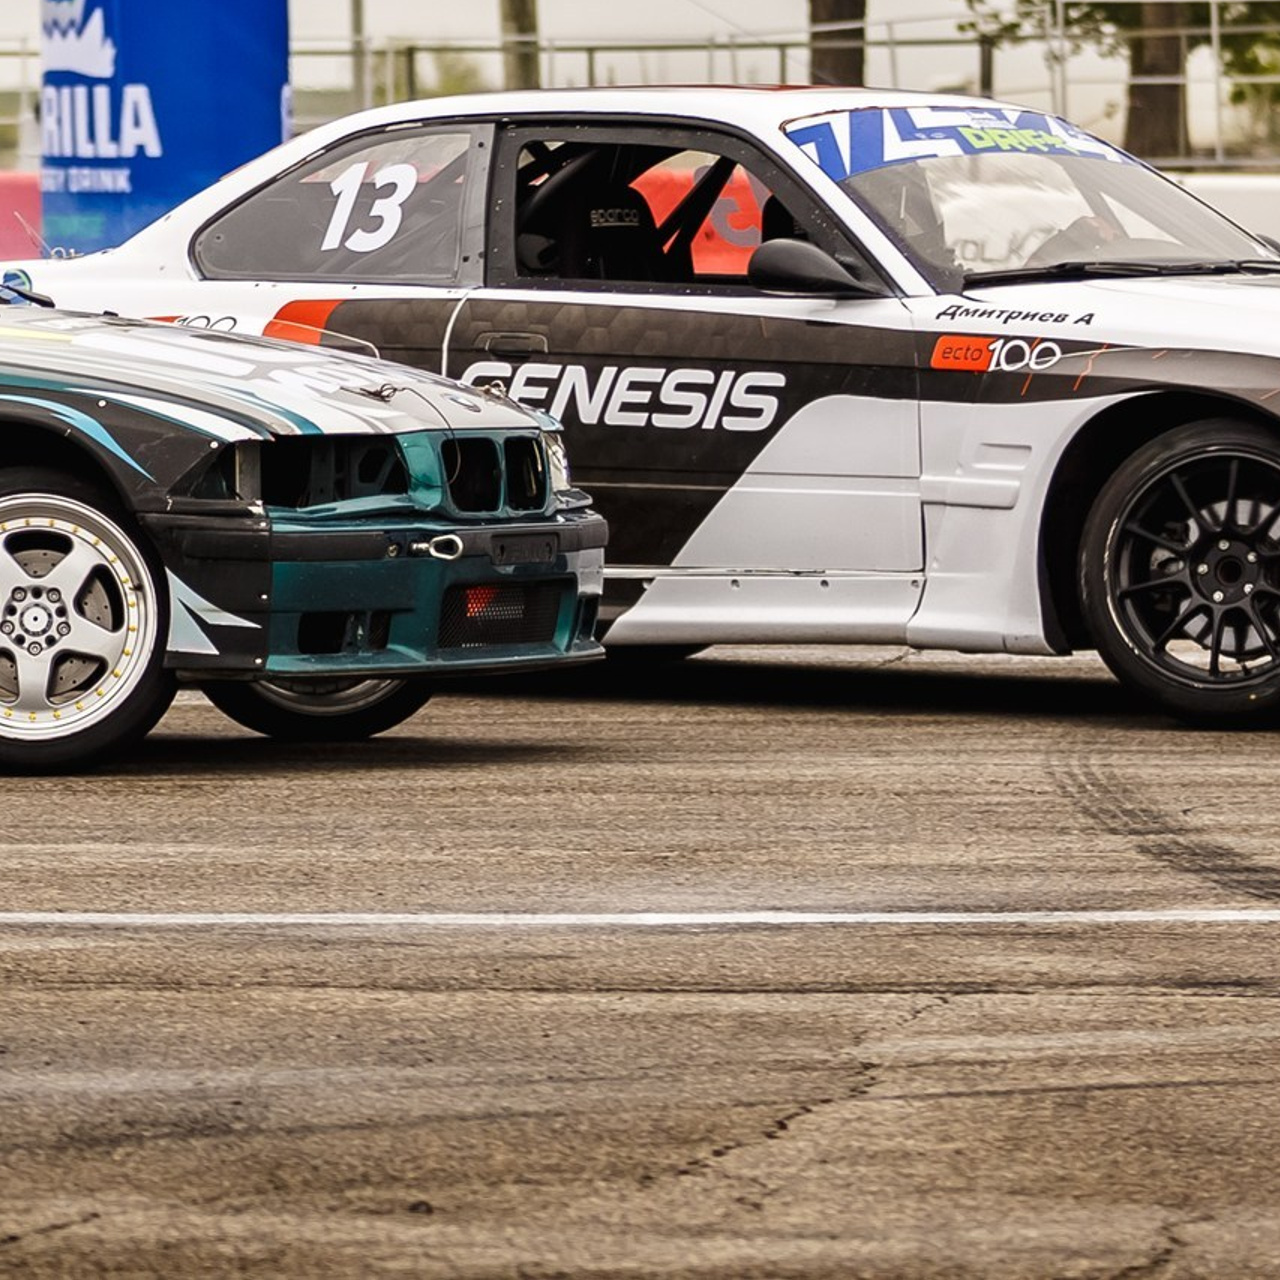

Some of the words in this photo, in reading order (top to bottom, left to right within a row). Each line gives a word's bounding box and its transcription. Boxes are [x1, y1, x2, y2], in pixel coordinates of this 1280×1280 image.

[321, 161, 418, 253] 13
[935, 304, 1070, 325] Дмитриев
[941, 345, 984, 362] ecto
[987, 338, 1062, 372] 100
